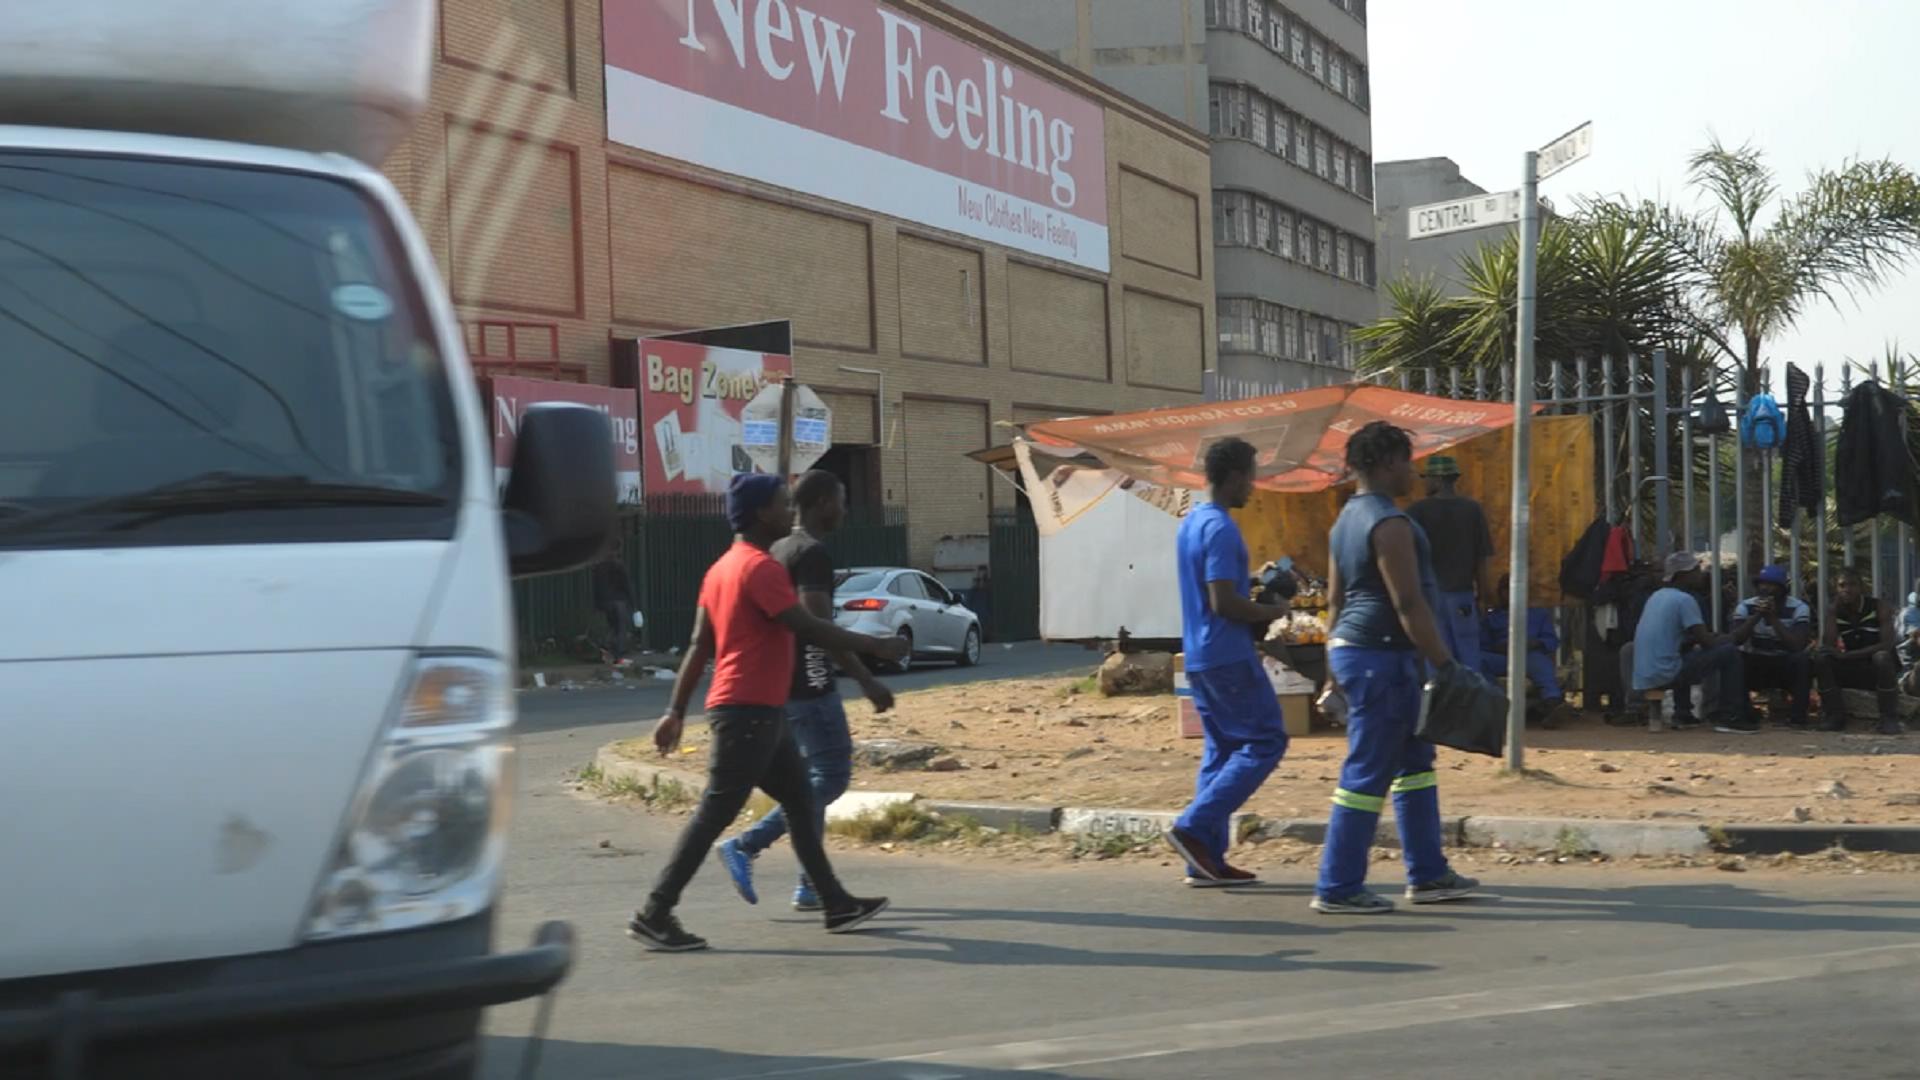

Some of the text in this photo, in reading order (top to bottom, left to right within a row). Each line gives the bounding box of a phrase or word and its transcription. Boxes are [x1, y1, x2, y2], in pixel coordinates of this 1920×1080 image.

[679, 0, 1076, 208] New Feeling
[958, 185, 1078, 258] New Clothes New Feeling
[1418, 203, 1476, 233] CENTRAL
[647, 354, 694, 405] Bag
